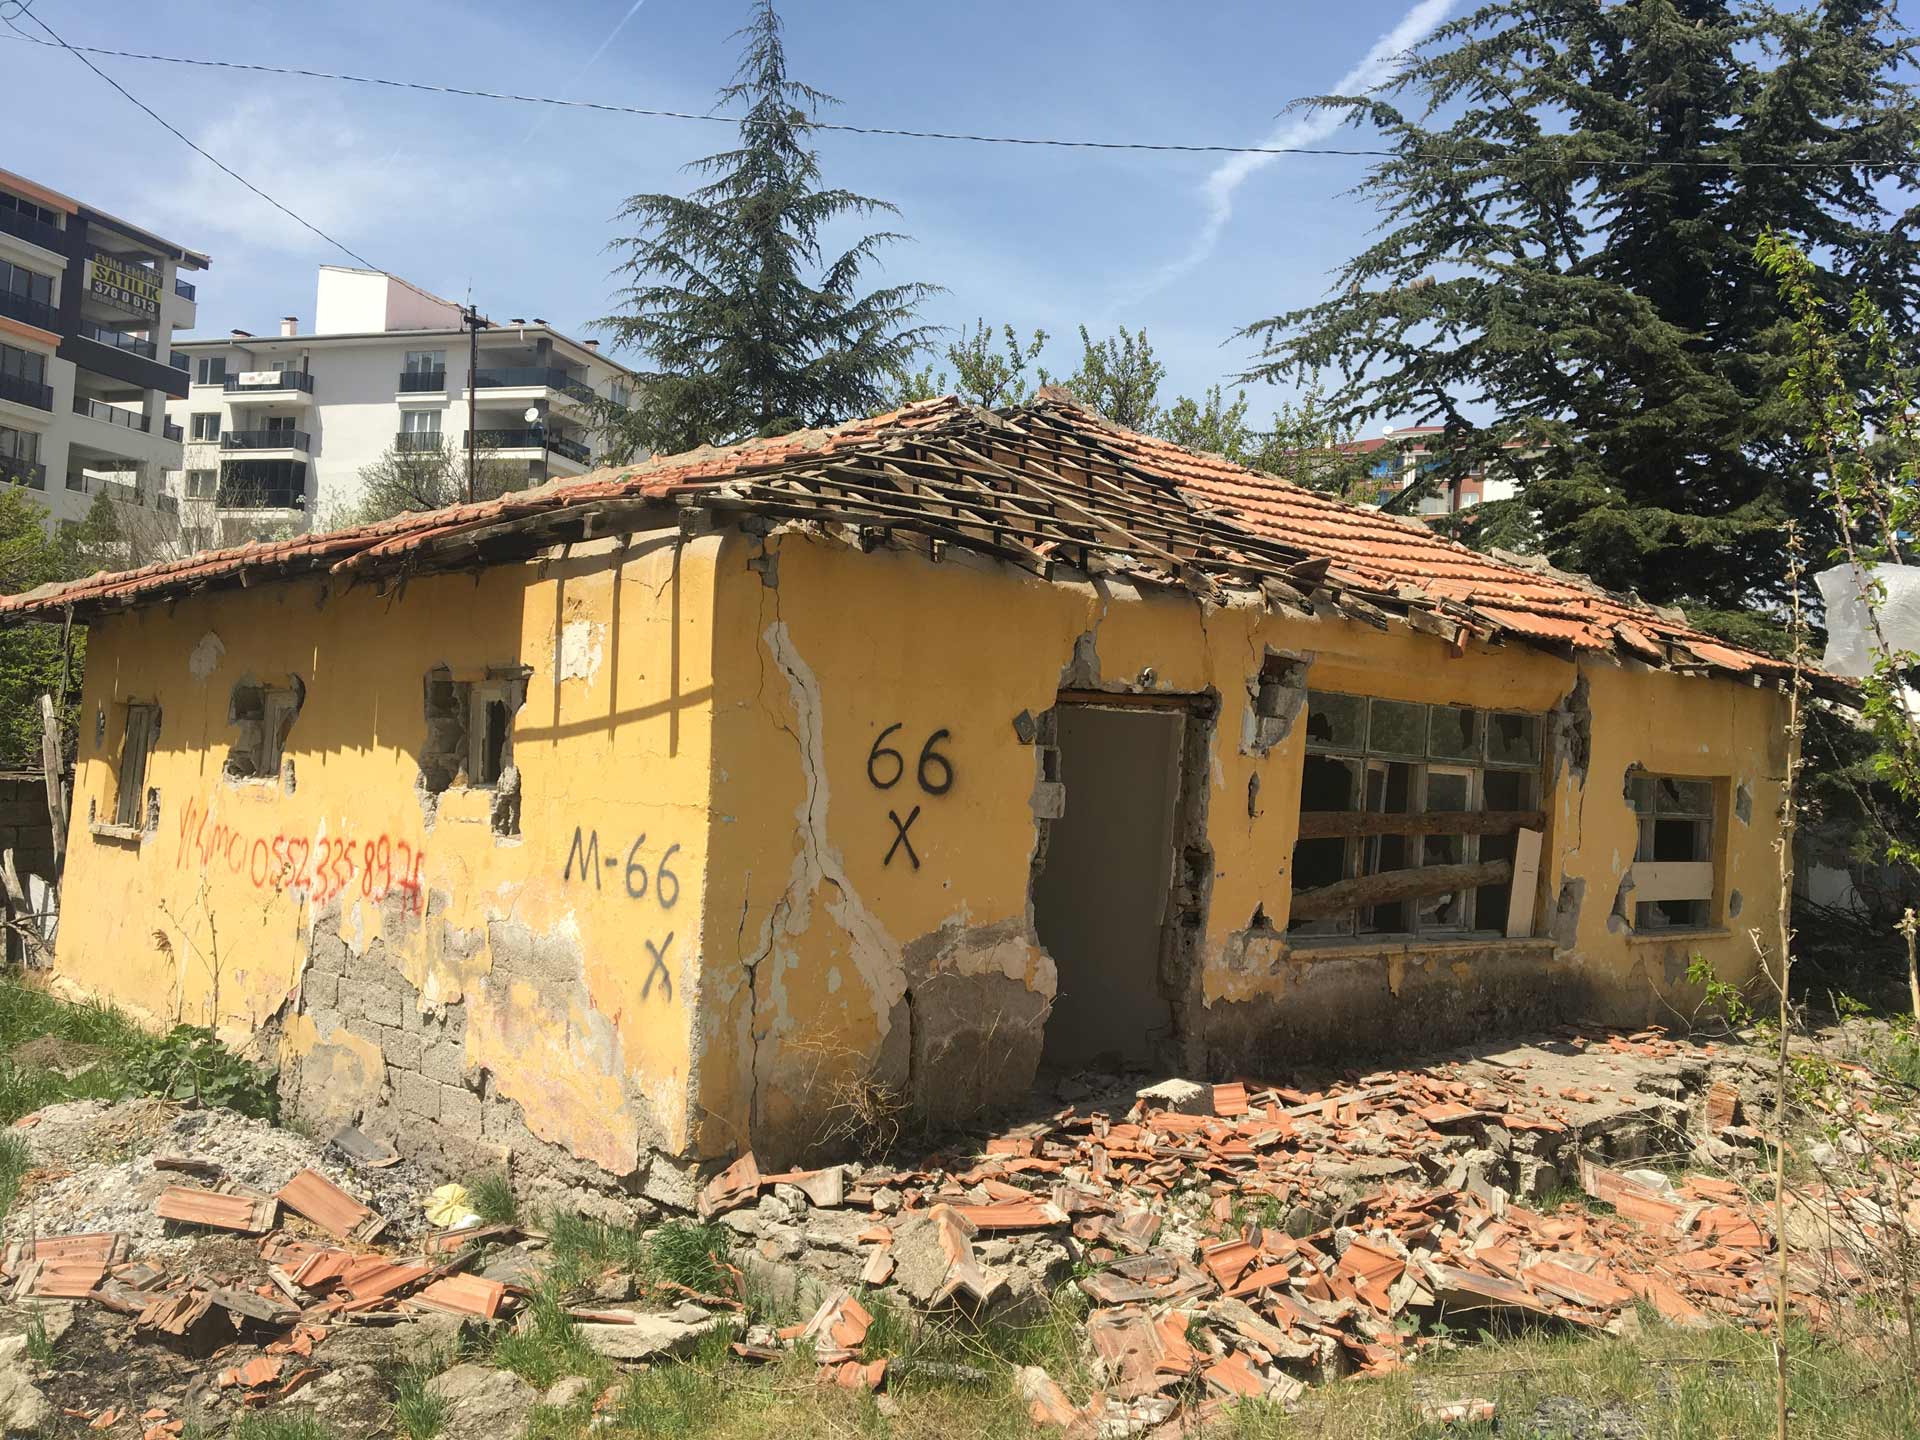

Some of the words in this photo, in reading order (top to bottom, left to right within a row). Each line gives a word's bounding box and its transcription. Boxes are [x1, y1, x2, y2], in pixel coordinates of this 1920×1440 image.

[95, 266, 159, 301] SATILIK
[95, 281, 118, 299] 376
[133, 295, 155, 313] 613
[868, 722, 953, 796] 66
[563, 825, 681, 909] M-66
[884, 806, 920, 870] X
[641, 931, 674, 1003] X
